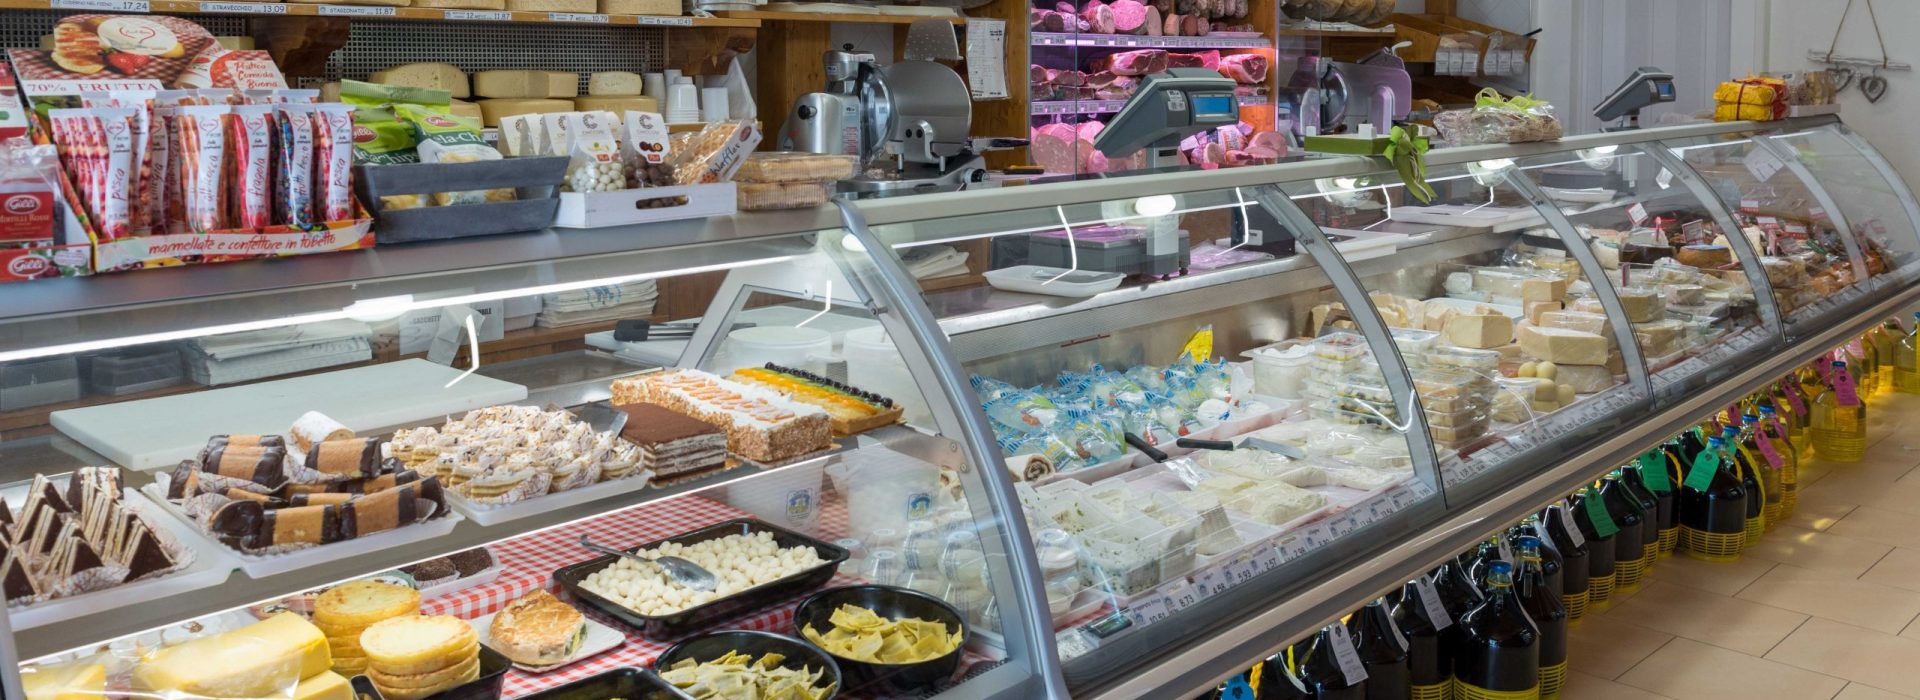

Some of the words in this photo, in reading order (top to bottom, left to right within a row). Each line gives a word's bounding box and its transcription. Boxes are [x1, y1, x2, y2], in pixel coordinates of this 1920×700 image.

[27, 83, 67, 92] 70%
[77, 83, 161, 92] FRUTTA
[112, 167, 127, 201] pesca
[149, 235, 215, 254] marmellate
[217, 240, 226, 249] e
[228, 235, 282, 254] confetture
[285, 237, 296, 248] in
[12, 260, 43, 272] Gilli
